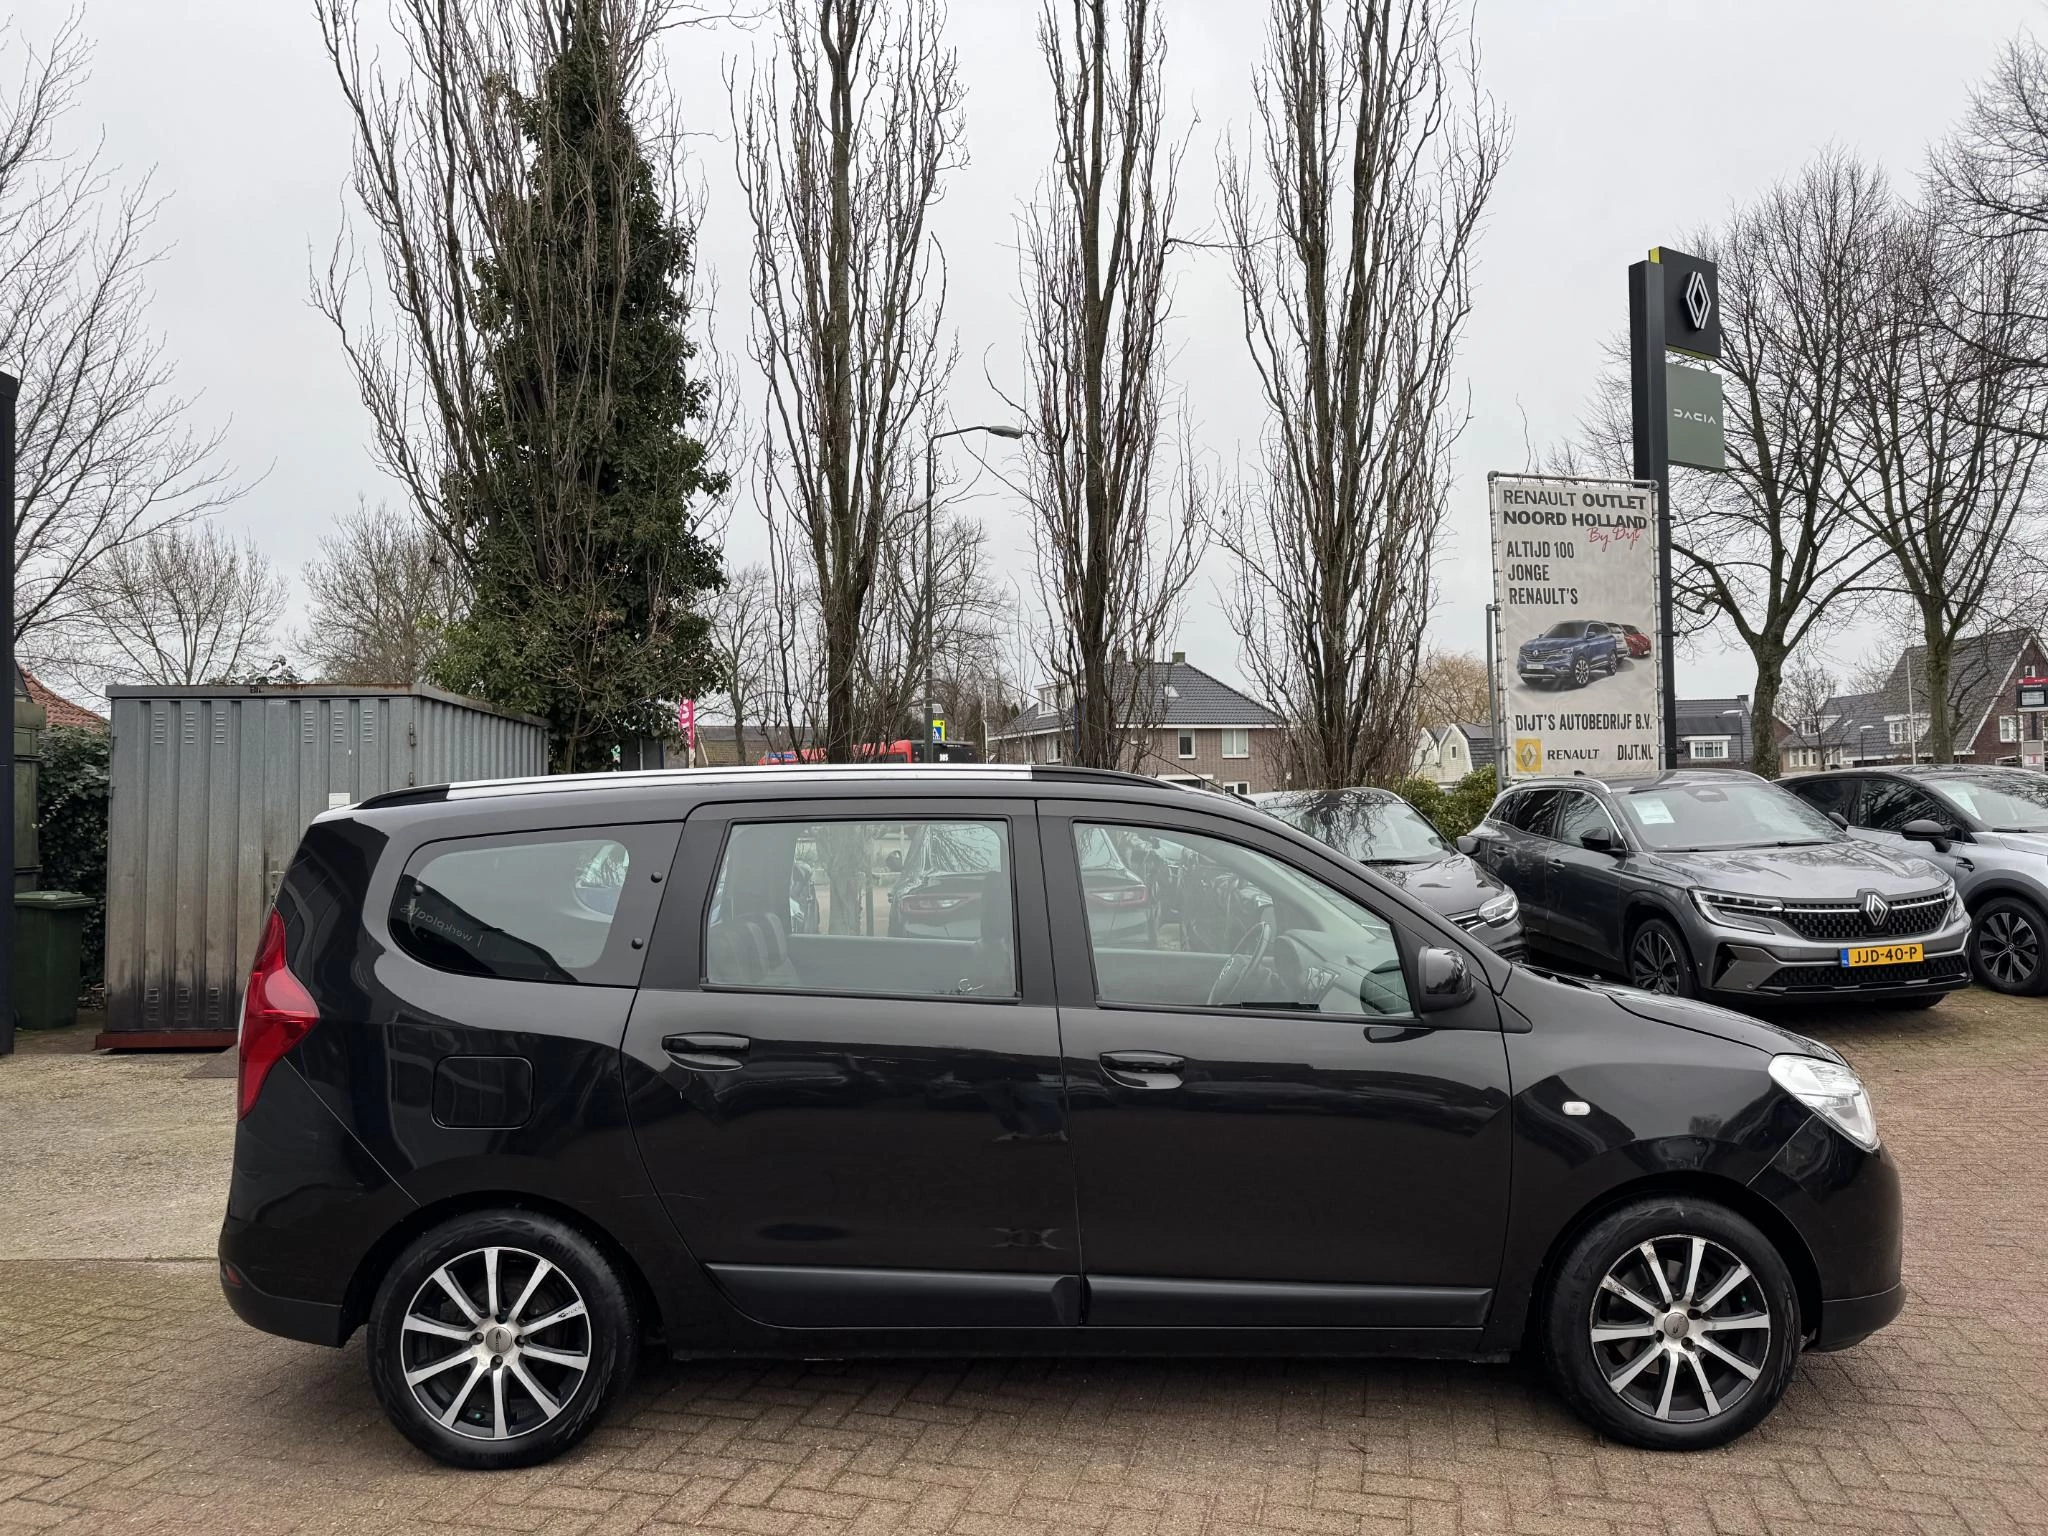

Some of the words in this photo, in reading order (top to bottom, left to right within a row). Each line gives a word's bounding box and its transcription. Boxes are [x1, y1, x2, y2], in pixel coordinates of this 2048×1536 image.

[1673, 408, 1717, 425] DACIA
[1503, 489, 1576, 507] RENAULT
[1582, 493, 1647, 510] OUTLET
[1503, 510, 1567, 526] NOORD
[1571, 512, 1648, 530] HOLLAND
[1586, 527, 1612, 553] By
[1507, 541, 1551, 558] ALTIJD
[1554, 541, 1575, 559] 100
[1507, 564, 1550, 581] JONGE
[1509, 587, 1578, 605] RENAULT'S
[1515, 713, 1556, 731] DIJT'S
[1559, 713, 1632, 730] AUTOBEDRIJF
[1635, 713, 1653, 730] B.V.
[1547, 749, 1600, 760] RENAULT
[1617, 744, 1654, 761] DIJT.NL
[1854, 946, 1918, 964] JJD-40-P
